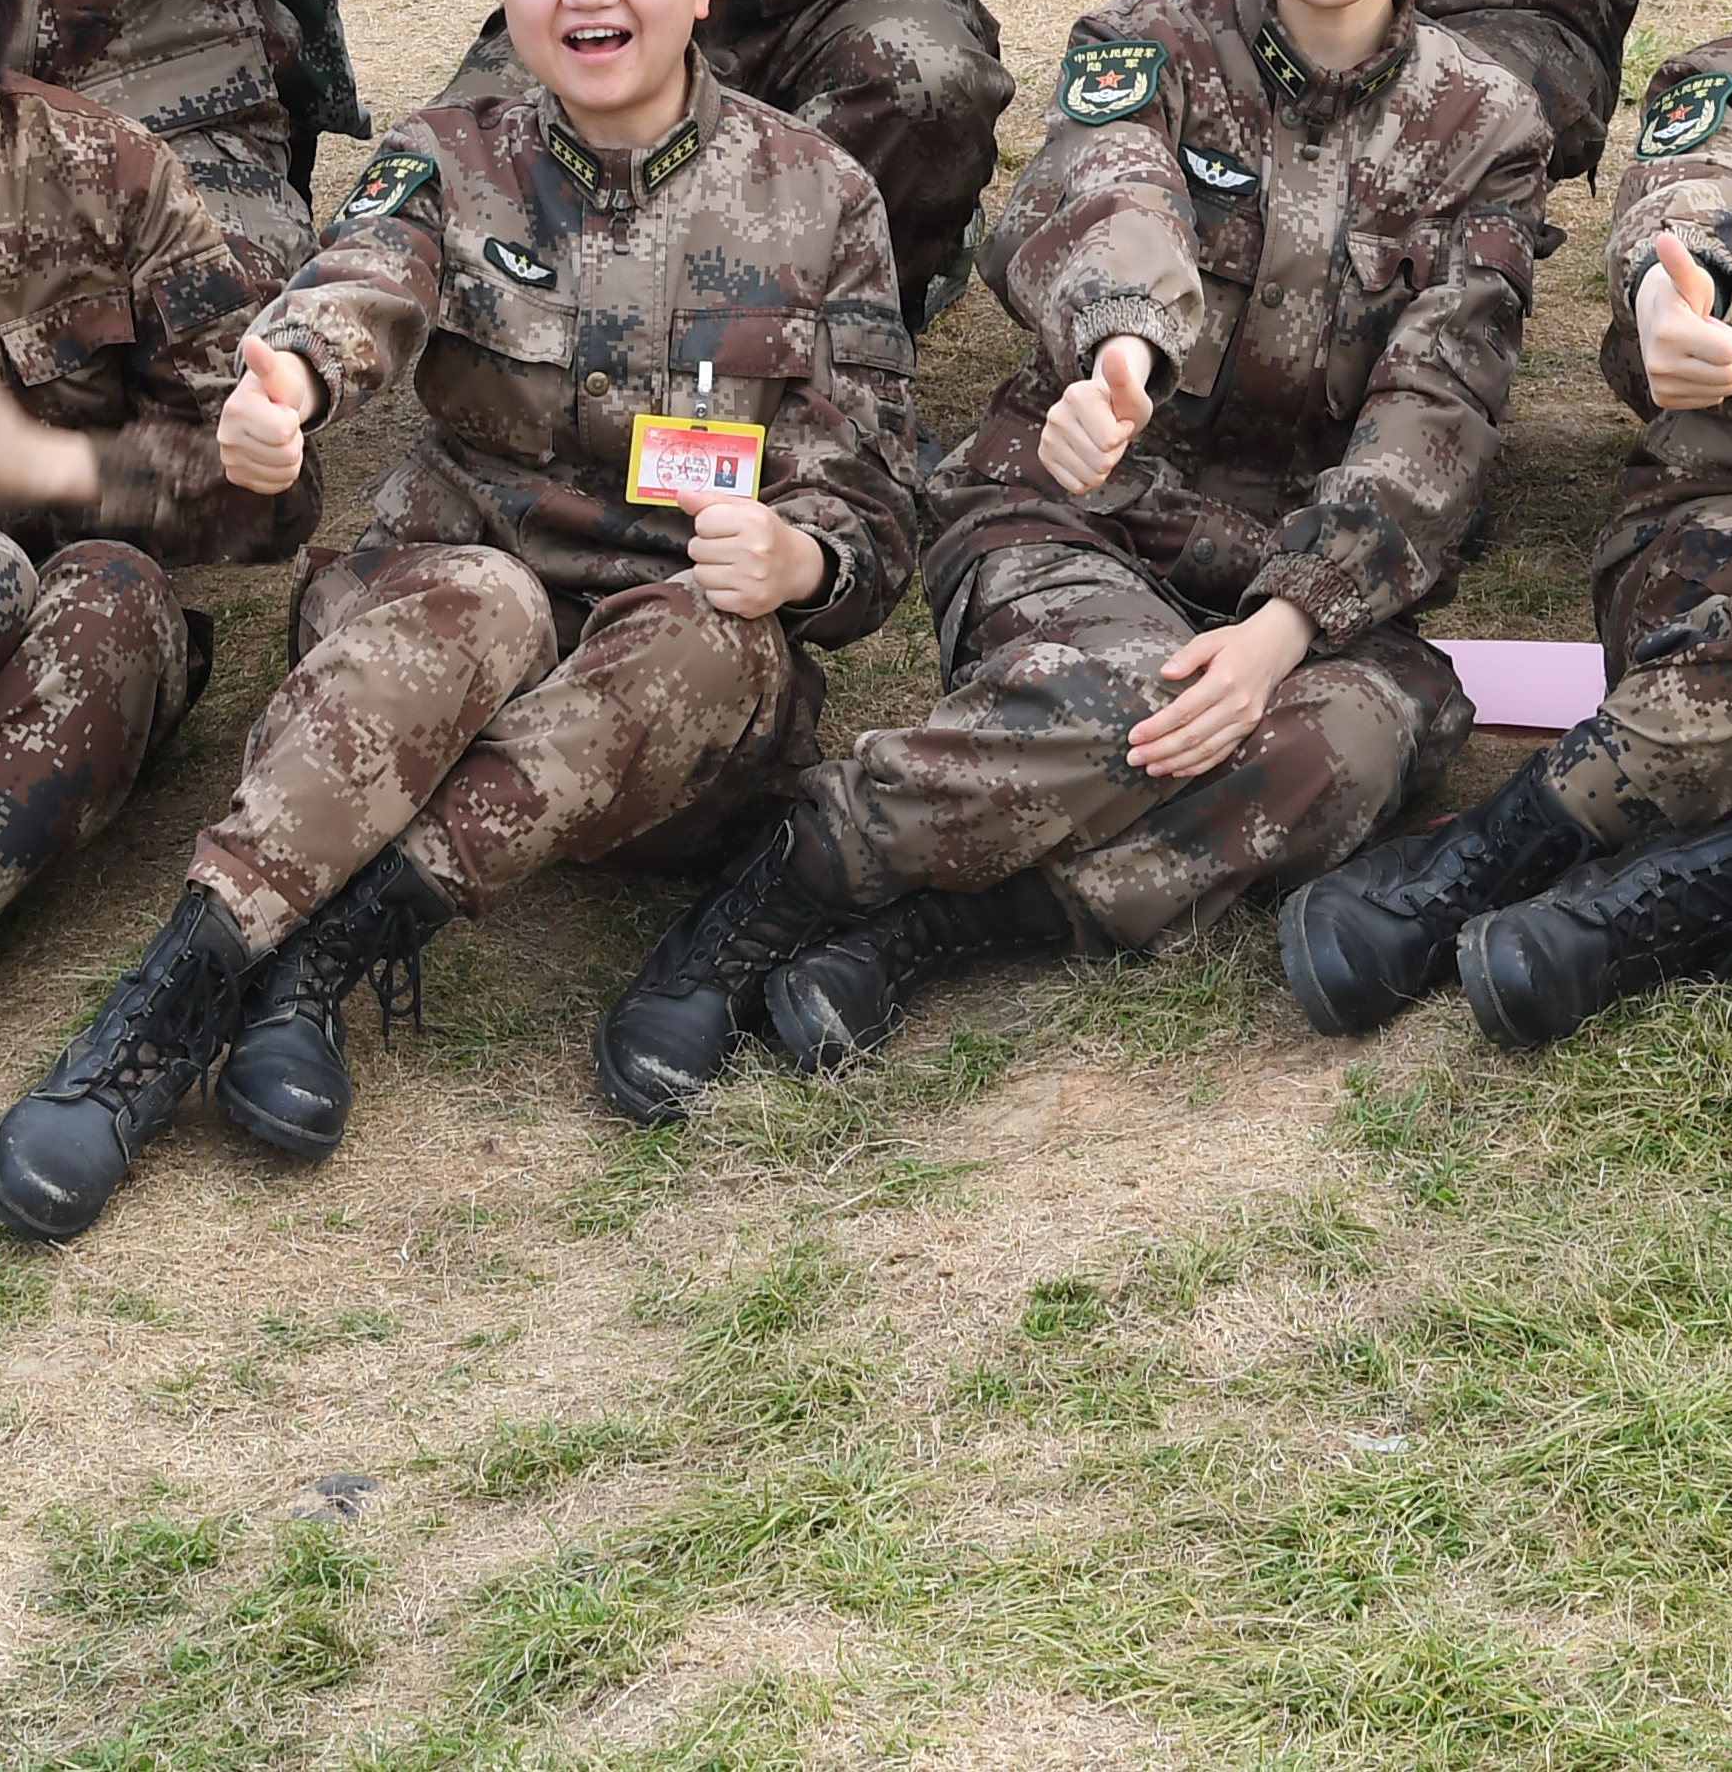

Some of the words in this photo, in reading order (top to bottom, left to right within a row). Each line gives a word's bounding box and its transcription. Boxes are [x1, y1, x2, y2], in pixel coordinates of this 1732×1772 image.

[1073, 46, 1157, 64] 中国人民解放军
